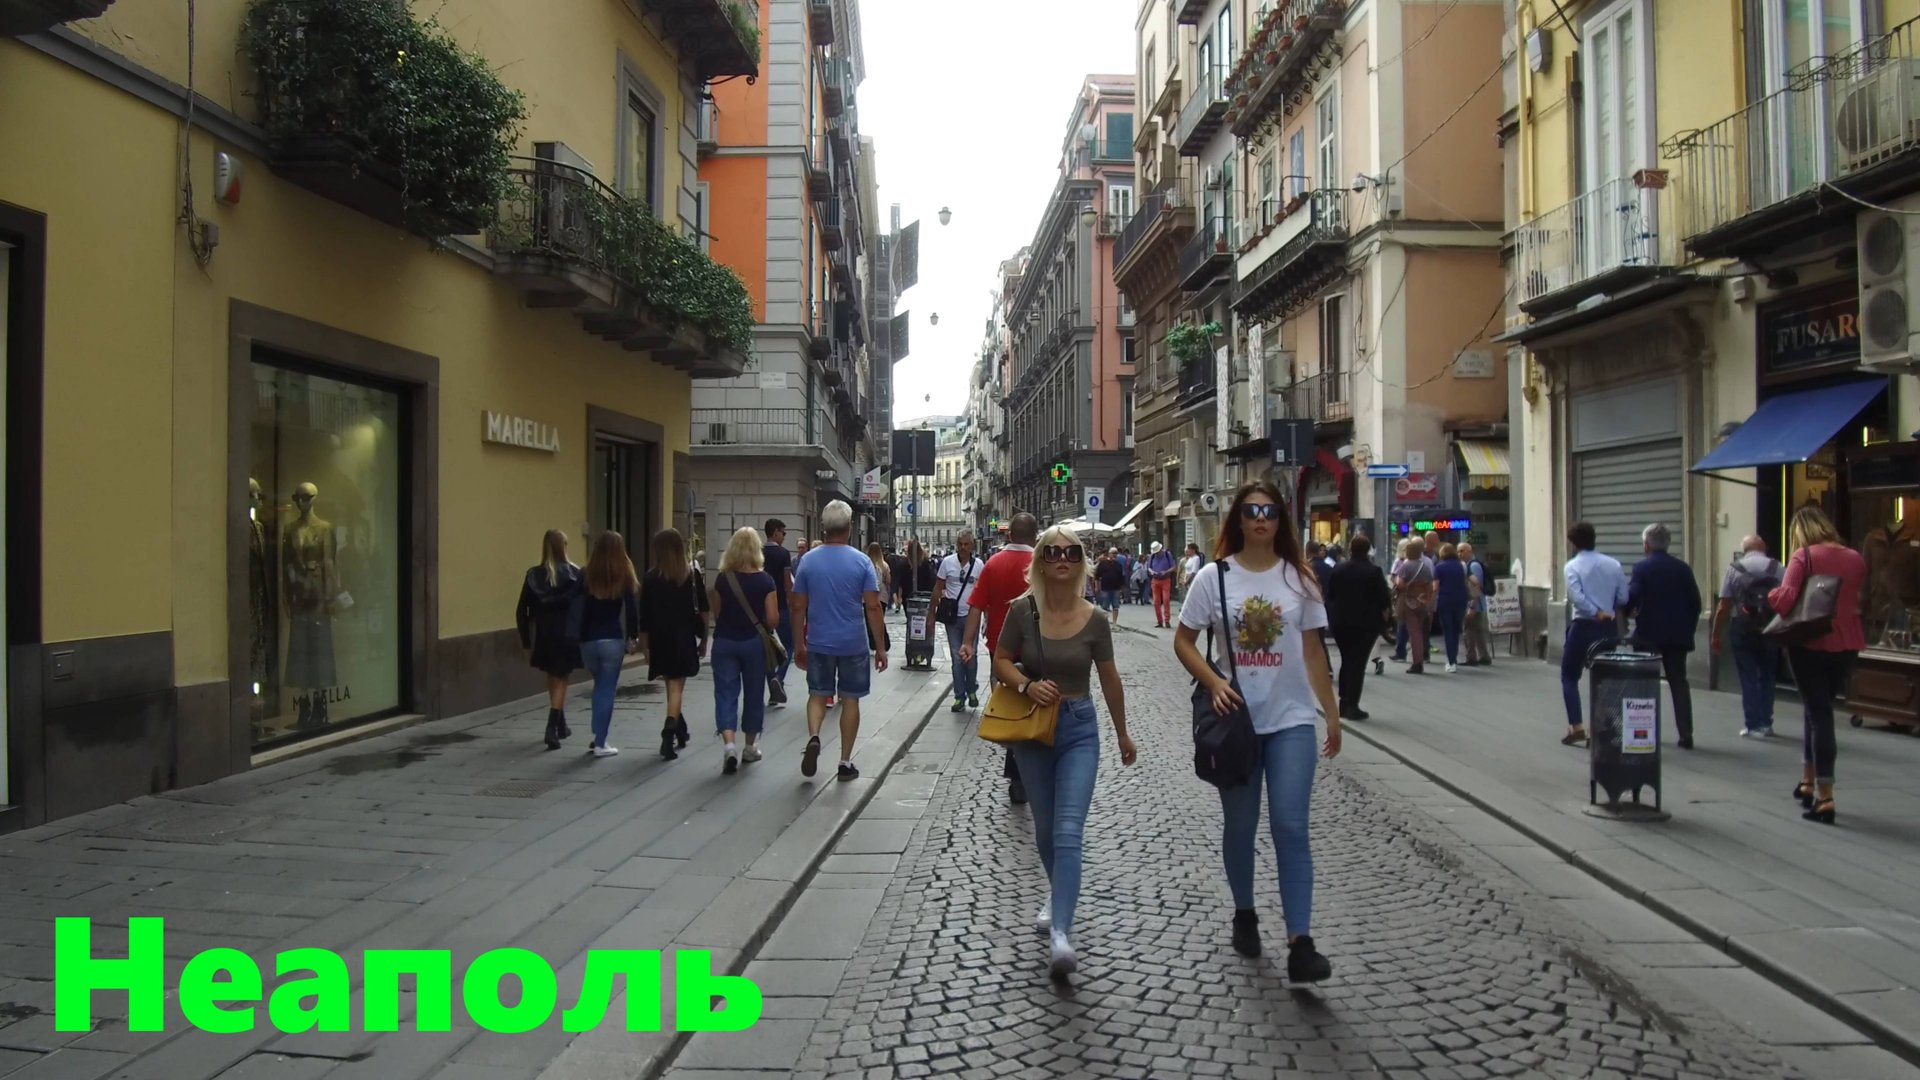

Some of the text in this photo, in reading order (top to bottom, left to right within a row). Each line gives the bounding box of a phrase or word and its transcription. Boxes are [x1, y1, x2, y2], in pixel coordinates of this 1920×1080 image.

[1776, 314, 1860, 354] FUSAR
[487, 410, 560, 452] MARELLA
[292, 685, 351, 712] MARELLA
